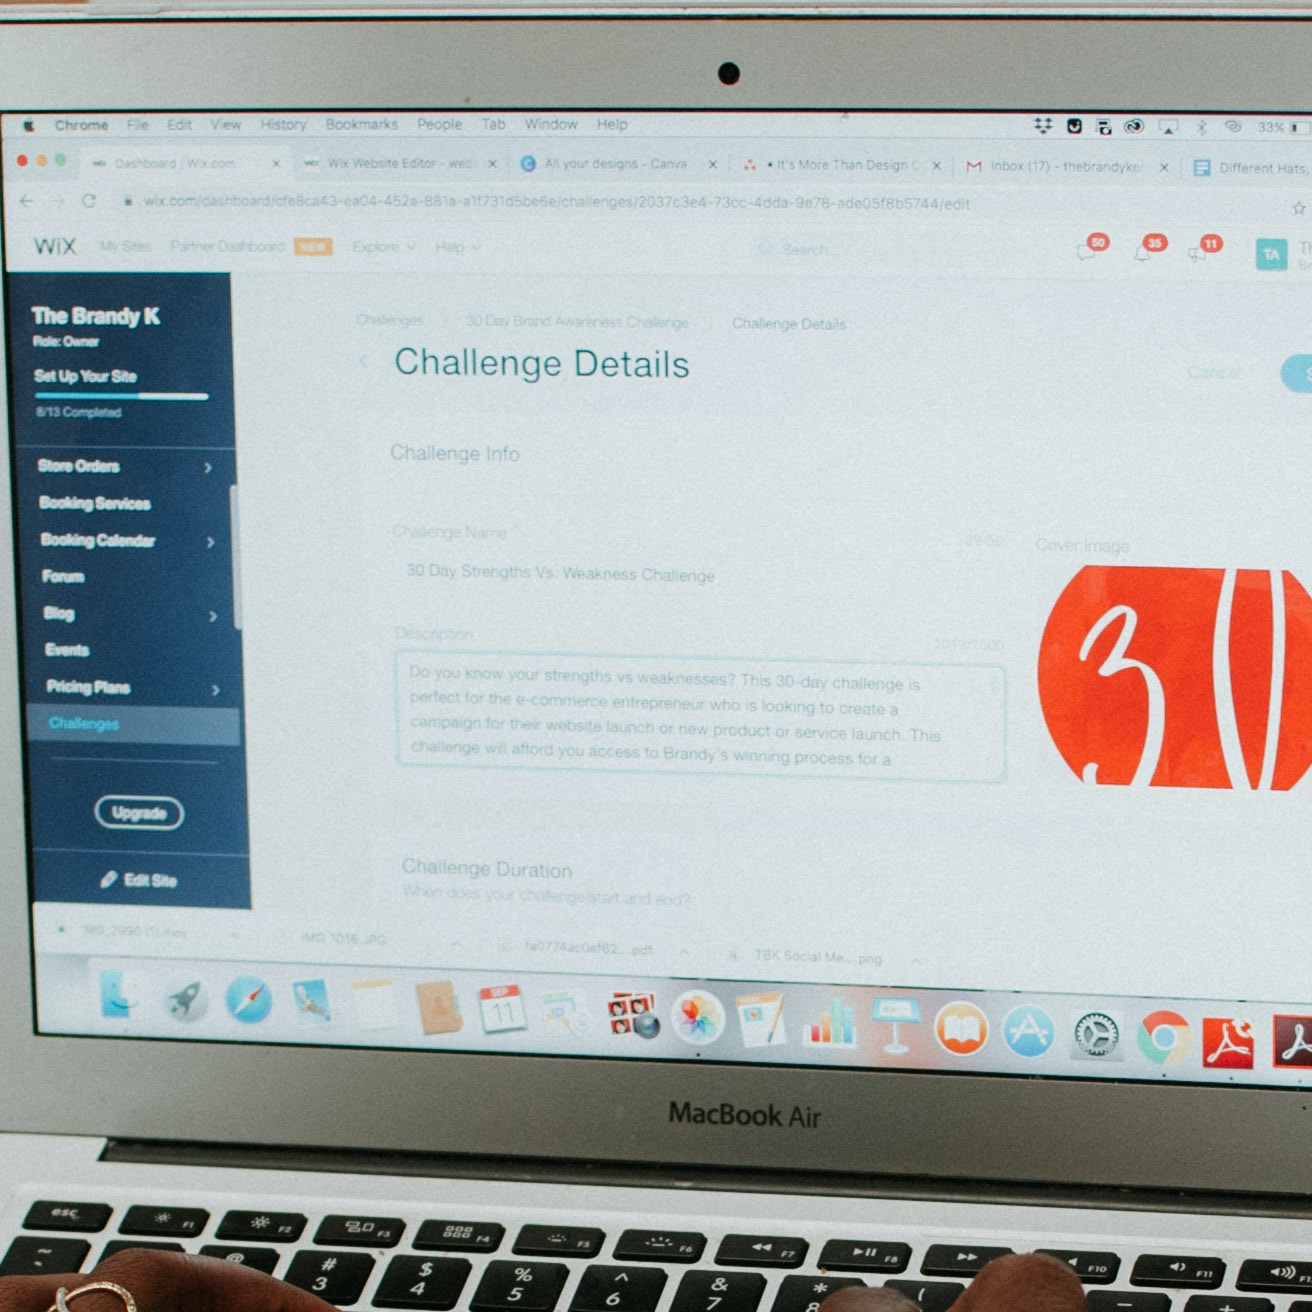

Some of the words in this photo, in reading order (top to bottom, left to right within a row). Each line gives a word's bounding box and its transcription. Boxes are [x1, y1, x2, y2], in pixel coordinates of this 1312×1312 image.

[54, 119, 109, 131] Chrome
[127, 119, 148, 130] File
[168, 119, 192, 130] Edit
[210, 119, 241, 130] View
[261, 118, 306, 133] History
[326, 118, 398, 130] Bookmarks
[417, 118, 462, 132] People
[483, 118, 505, 130] Tab
[525, 118, 578, 130] Window
[597, 118, 628, 132] Help
[1258, 122, 1285, 133] 33%
[116, 158, 176, 169] Dashboard
[189, 158, 235, 169] Wix.com
[329, 157, 348, 168] Wix
[353, 157, 397, 169] Website
[402, 157, 435, 169] Editor
[545, 158, 559, 169] All
[564, 160, 588, 172] your
[592, 158, 637, 172] designs
[651, 158, 687, 169] Canva
[799, 159, 829, 170] More
[833, 159, 862, 170] Than
[866, 159, 907, 173] Design
[991, 160, 1023, 172] Inbox
[1028, 160, 1050, 174] (17)
[1206, 239, 1217, 248] 11
[32, 307, 68, 325] The
[72, 307, 140, 328] Brandy
[144, 307, 160, 325] K
[732, 317, 798, 331] Challenge
[801, 318, 846, 331] Details
[63, 336, 100, 348] Owner
[394, 346, 562, 383] Challenge
[575, 349, 690, 379] Details
[34, 370, 57, 383] Set
[59, 370, 78, 385] Up
[81, 370, 109, 383] Your
[112, 370, 137, 383] Site
[390, 443, 480, 465] Challenge
[486, 445, 520, 462] Info
[38, 459, 73, 473] Store
[75, 459, 120, 473] Orders
[39, 495, 94, 512] Booking
[95, 496, 151, 511] Services
[41, 533, 95, 549] Booking
[97, 533, 156, 547] Calendar
[42, 569, 85, 584] Forum
[407, 563, 425, 577] 30
[428, 564, 456, 579] Day
[461, 564, 530, 582] Strengths
[563, 566, 637, 581] Weakness
[641, 568, 715, 585] Challenge
[43, 606, 75, 623] Blog
[45, 642, 90, 657] Events
[410, 665, 430, 679] Do
[434, 668, 461, 682] you
[465, 666, 503, 680] know
[508, 670, 540, 684] your
[544, 669, 612, 685] strengths
[617, 671, 633, 684] vs
[638, 671, 736, 687] weaknesses?
[741, 673, 771, 687] This
[776, 674, 827, 691] 30-day
[832, 676, 903, 693] challenge
[908, 678, 920, 691] is
[47, 679, 92, 696] Pricing
[94, 680, 131, 694] Plans
[410, 690, 461, 706] perfect
[465, 691, 485, 704] for
[489, 693, 511, 705] the
[516, 694, 607, 708] e-commerce
[612, 697, 704, 712] entrepreneur
[710, 698, 741, 711] who
[745, 700, 758, 712] is
[762, 700, 815, 717] looking
[820, 702, 834, 715] to
[839, 703, 885, 716] create
[889, 706, 899, 716] a
[49, 716, 120, 732] Challenges
[410, 717, 481, 732] campaign
[485, 717, 505, 730] for
[510, 717, 541, 731] their
[545, 719, 602, 733] website
[606, 721, 654, 735] launch
[659, 724, 673, 735] or
[678, 724, 708, 736] new
[713, 724, 771, 740] product
[775, 727, 790, 738] or
[795, 727, 847, 741] service
[911, 729, 941, 742] This
[411, 740, 479, 756] challenge
[485, 741, 507, 754] will
[512, 742, 554, 757] afford
[558, 746, 584, 760] you
[589, 747, 640, 759] access
[645, 746, 658, 759] to
[664, 747, 729, 763] Brandy's
[733, 750, 790, 766] winning
[794, 753, 853, 768] process
[858, 753, 878, 766] for
[882, 756, 892, 766] a
[112, 805, 168, 822] Upgrade
[402, 858, 490, 878] Challenge
[496, 860, 572, 879] Duration
[124, 873, 149, 887] Edit
[152, 873, 178, 888] Site
[669, 1101, 782, 1127] MacBook
[789, 1105, 822, 1128] Air
[51, 1208, 80, 1218] esc
[1088, 1264, 1107, 1273] F10
[1196, 1270, 1213, 1278] F11
[312, 1277, 328, 1291] 3
[409, 1281, 425, 1296] 4
[507, 1287, 523, 1302] 5
[605, 1292, 620, 1306] 6
[707, 1297, 722, 1311] 7
